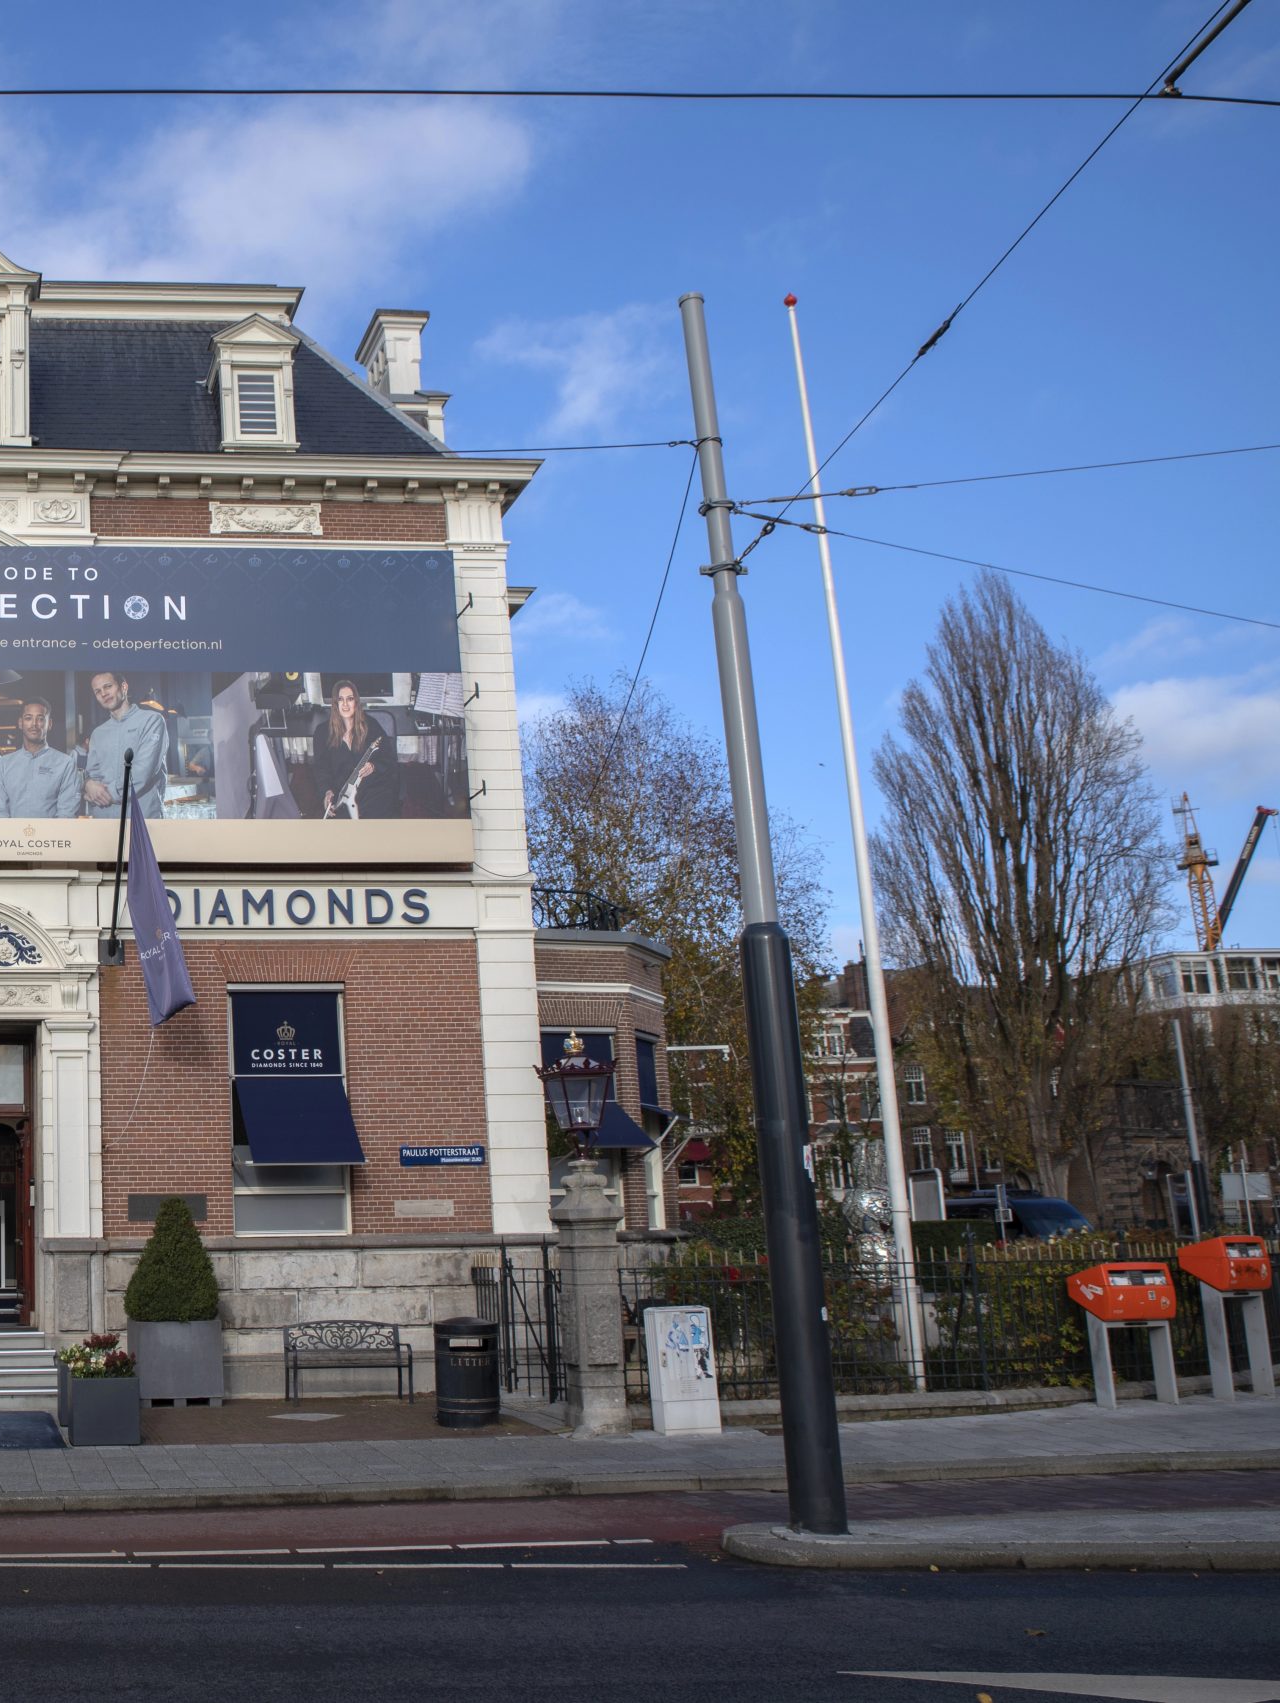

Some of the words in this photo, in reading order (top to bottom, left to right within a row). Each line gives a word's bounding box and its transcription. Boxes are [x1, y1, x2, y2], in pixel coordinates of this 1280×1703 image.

[4, 566, 54, 581] ODE
[68, 567, 99, 582] TO
[12, 638, 77, 649] entrance
[93, 638, 223, 651] odetoperfection.nl
[27, 839, 72, 848] COSTER
[250, 1048, 322, 1060] COSTER
[402, 1148, 428, 1157] PAULUS
[429, 1147, 480, 1157] POTTERSTRAAT
